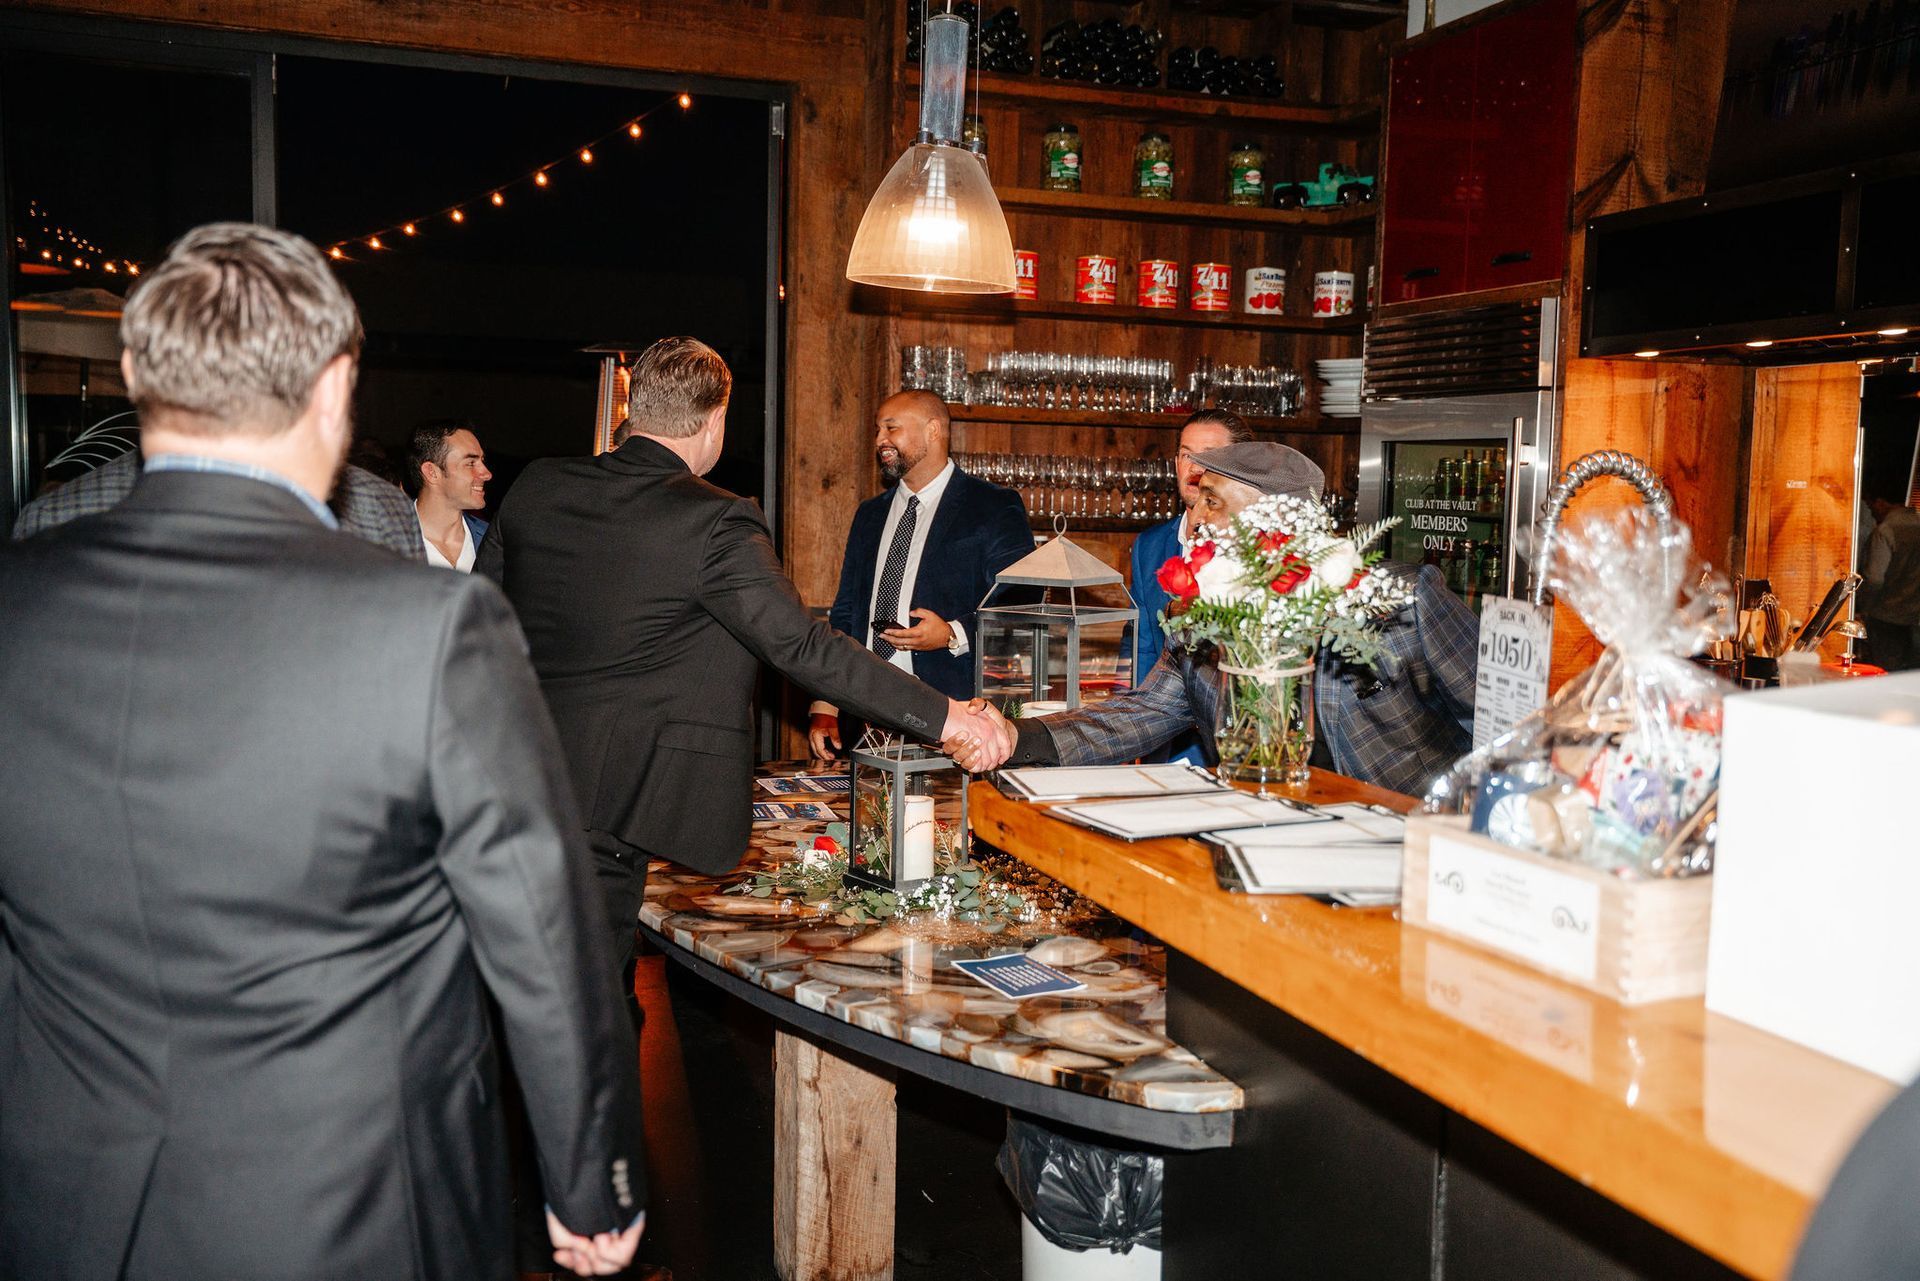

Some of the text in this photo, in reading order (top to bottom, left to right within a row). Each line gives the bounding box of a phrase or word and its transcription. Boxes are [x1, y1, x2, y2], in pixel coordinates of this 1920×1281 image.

[1197, 266, 1227, 290] 7/11
[1405, 498, 1477, 511] CLUB AT THE VAULT
[1410, 514, 1468, 532] MEMBERS
[1423, 534, 1456, 552] ONLY
[1491, 631, 1532, 672] 1950
